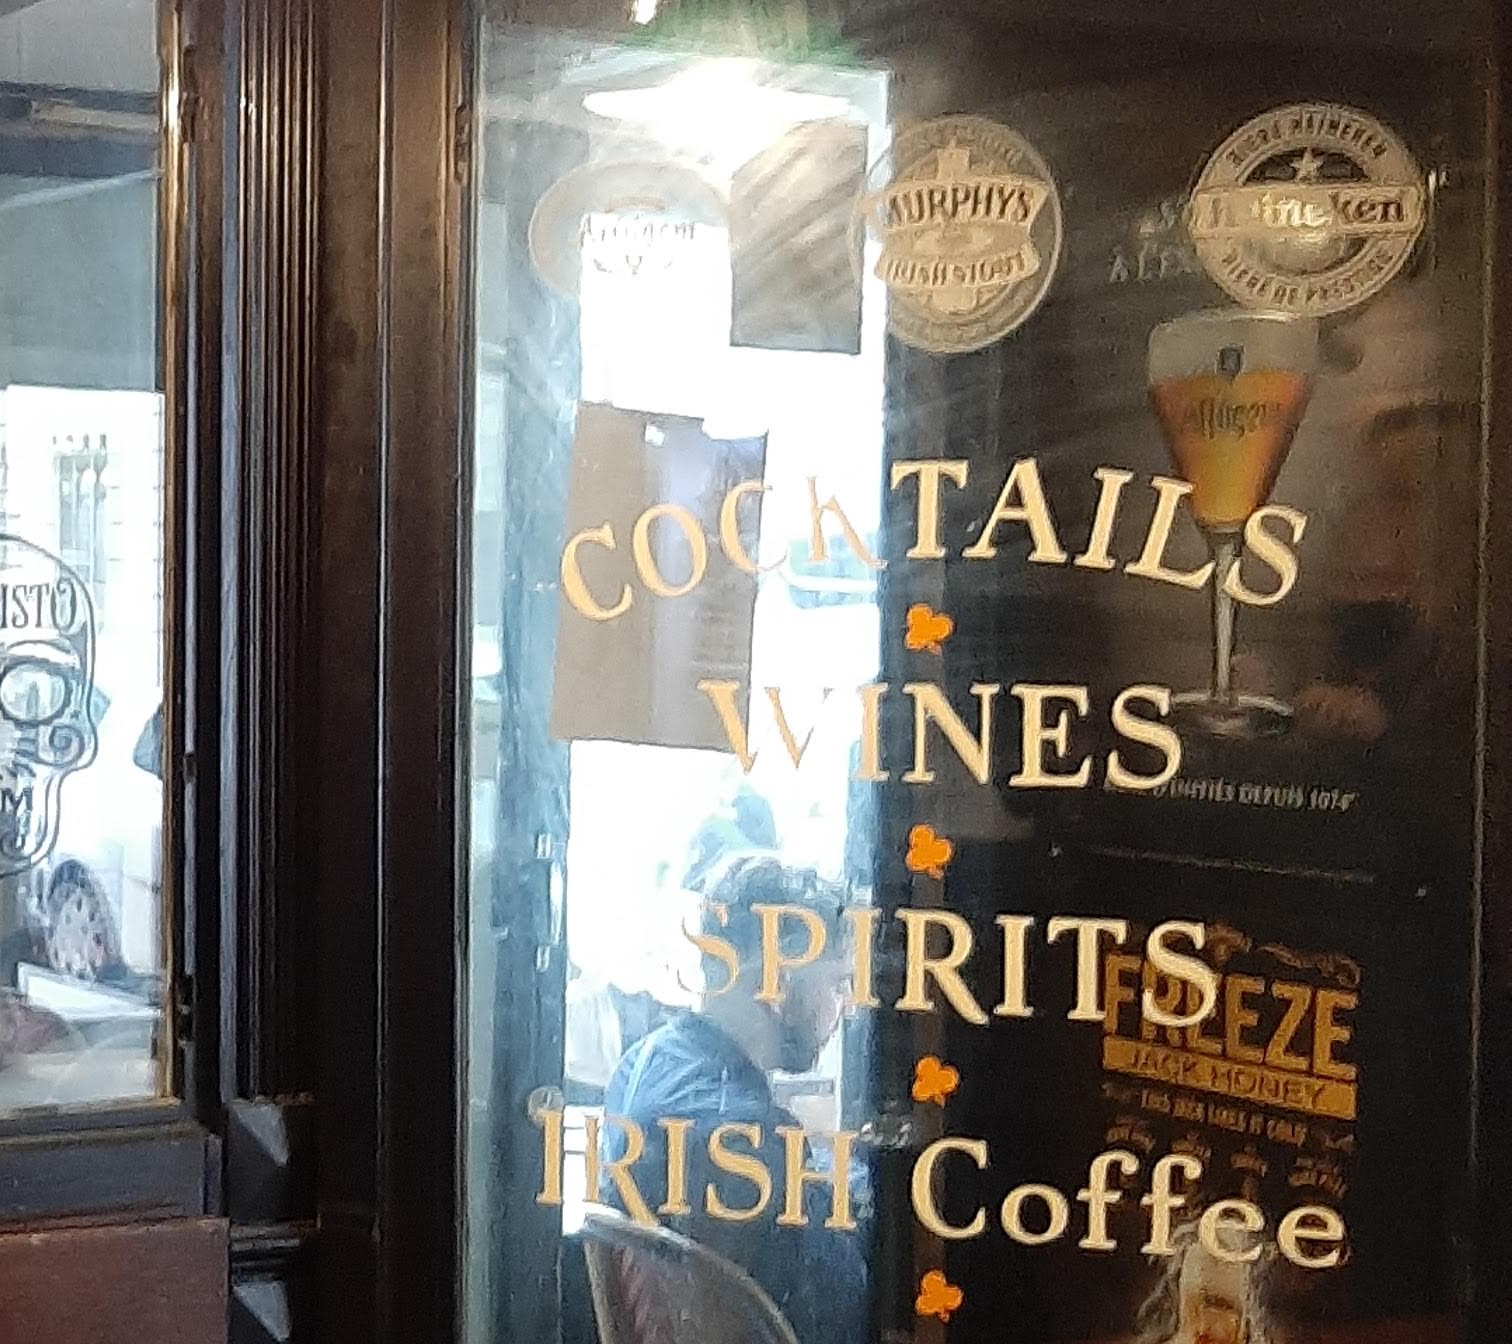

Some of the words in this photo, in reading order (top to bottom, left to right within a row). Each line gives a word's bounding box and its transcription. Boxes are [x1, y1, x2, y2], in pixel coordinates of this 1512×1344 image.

[558, 456, 1310, 623] COCKTAILS
[696, 678, 1184, 791] WINES
[676, 902, 1218, 1028] SPIRITS
[537, 1106, 860, 1233] IRISH
[910, 1136, 1347, 1270] Coffee
